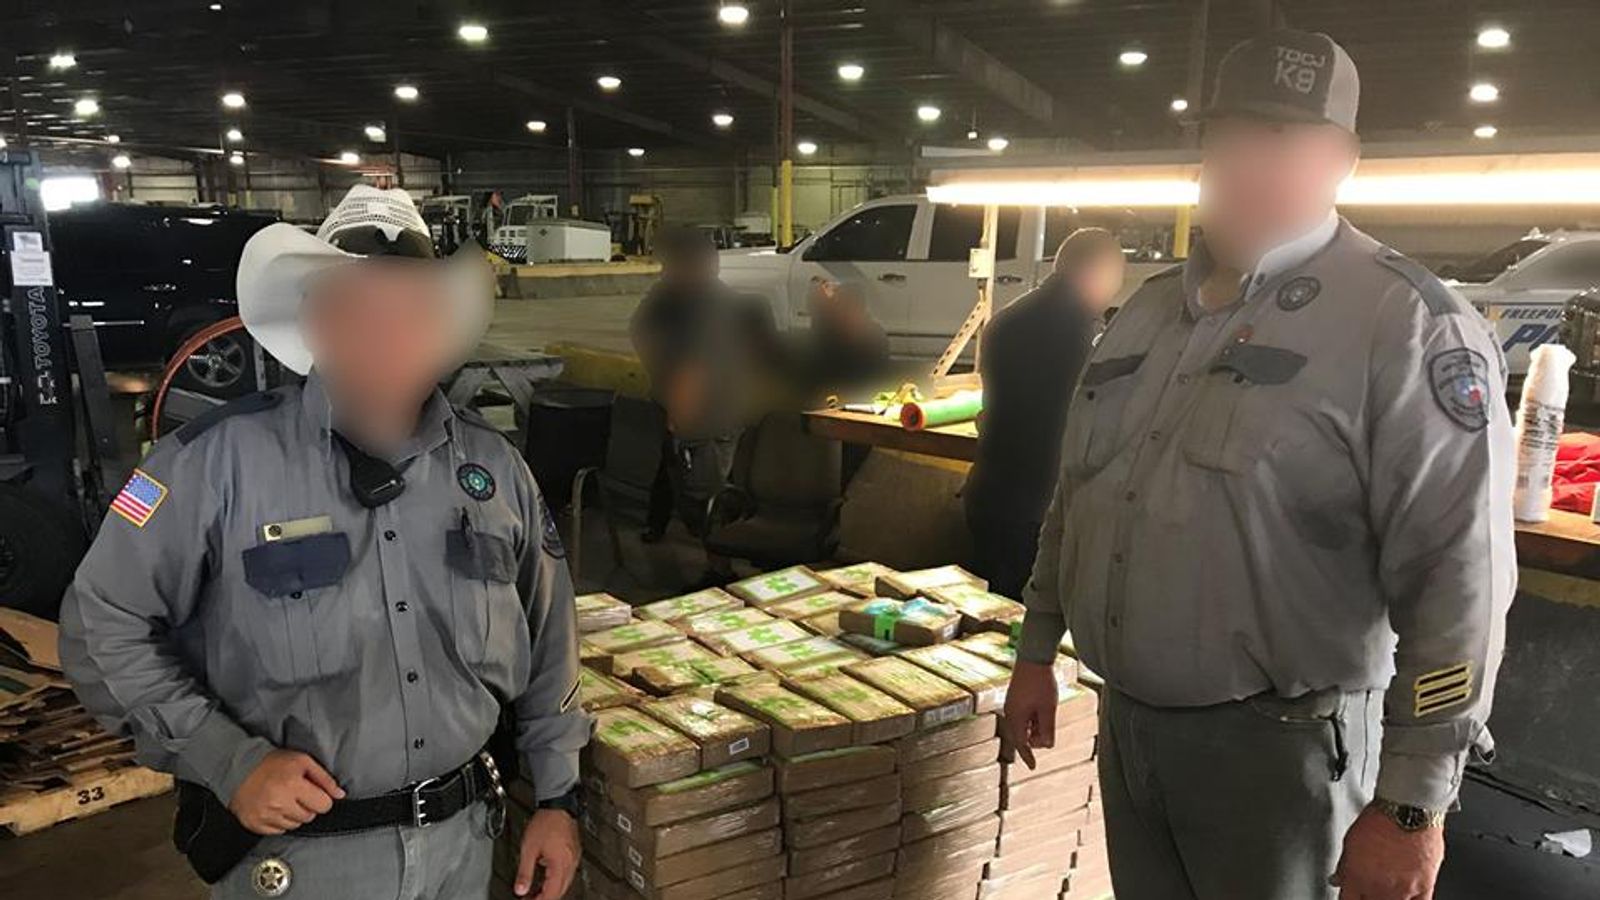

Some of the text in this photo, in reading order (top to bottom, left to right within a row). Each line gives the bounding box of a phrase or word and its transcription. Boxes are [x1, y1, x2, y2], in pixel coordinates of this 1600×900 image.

[1274, 60, 1317, 94] K9
[27, 285, 53, 371] TOYOTA
[76, 785, 106, 805] 33
